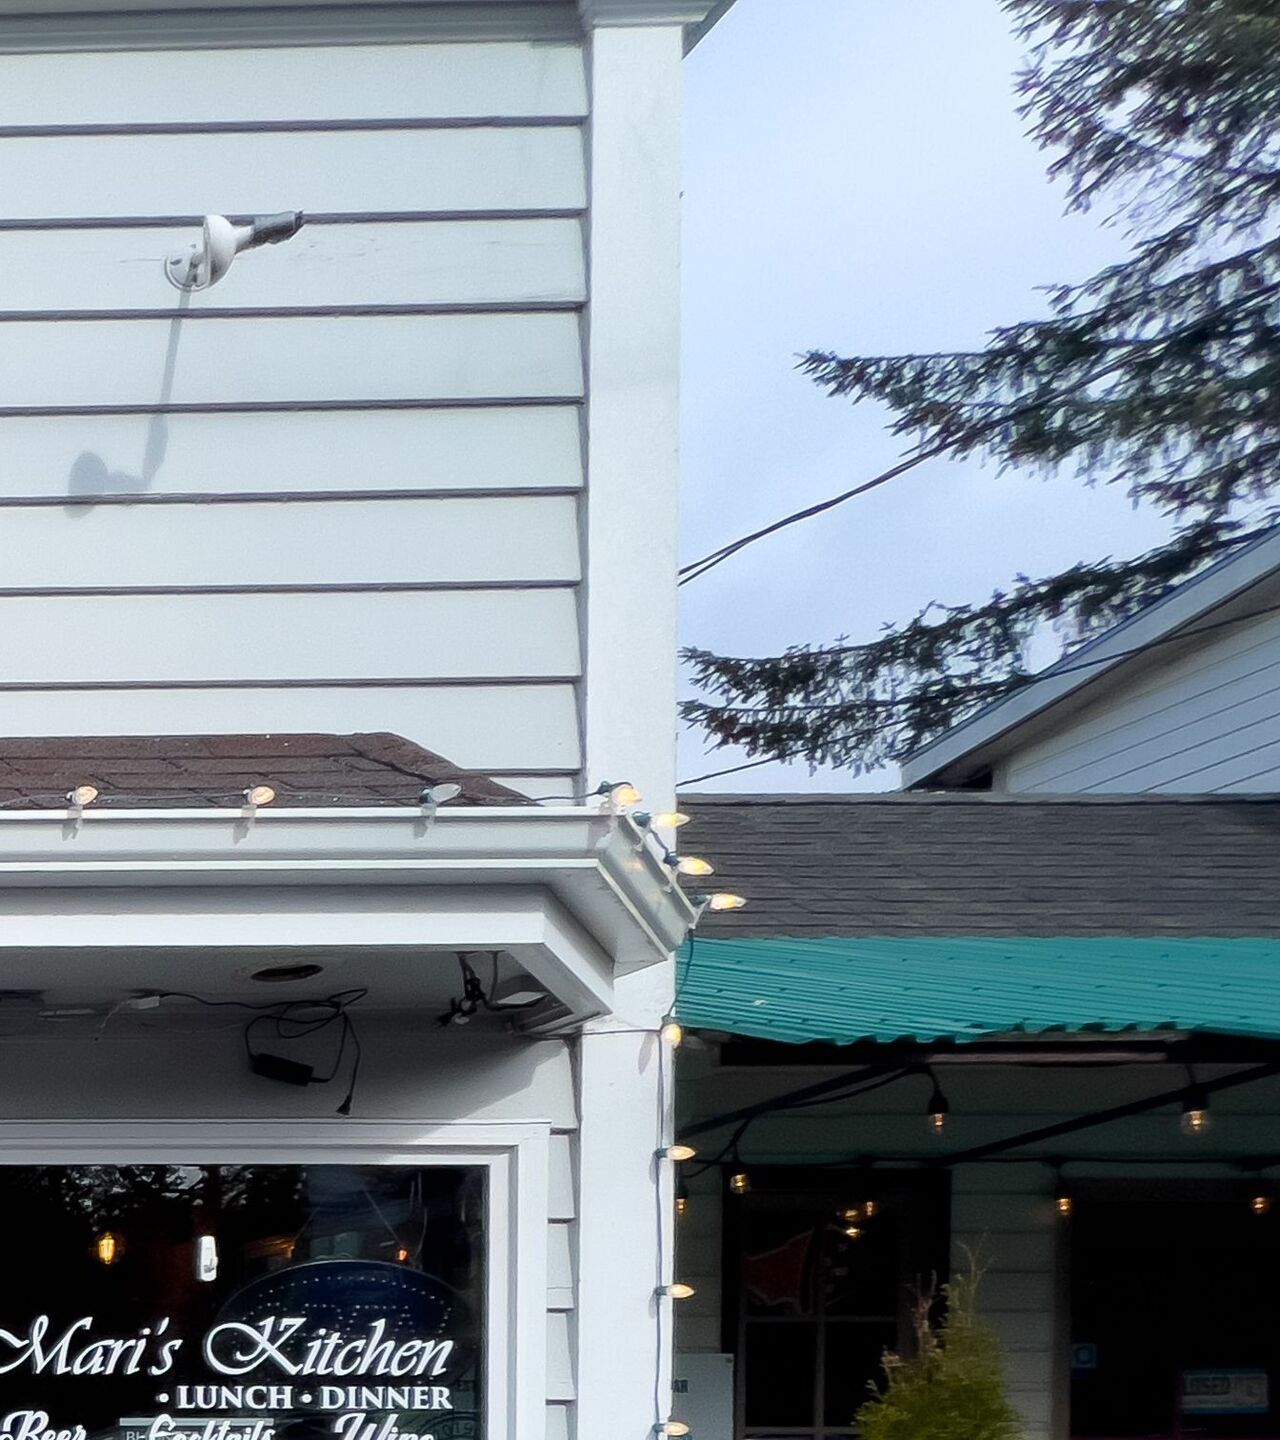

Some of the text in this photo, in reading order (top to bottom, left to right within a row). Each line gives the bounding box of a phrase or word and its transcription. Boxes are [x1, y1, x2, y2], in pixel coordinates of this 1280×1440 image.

[206, 1317, 454, 1376] Kitchen
[178, 1386, 453, 1410] LUNCH DINNER
